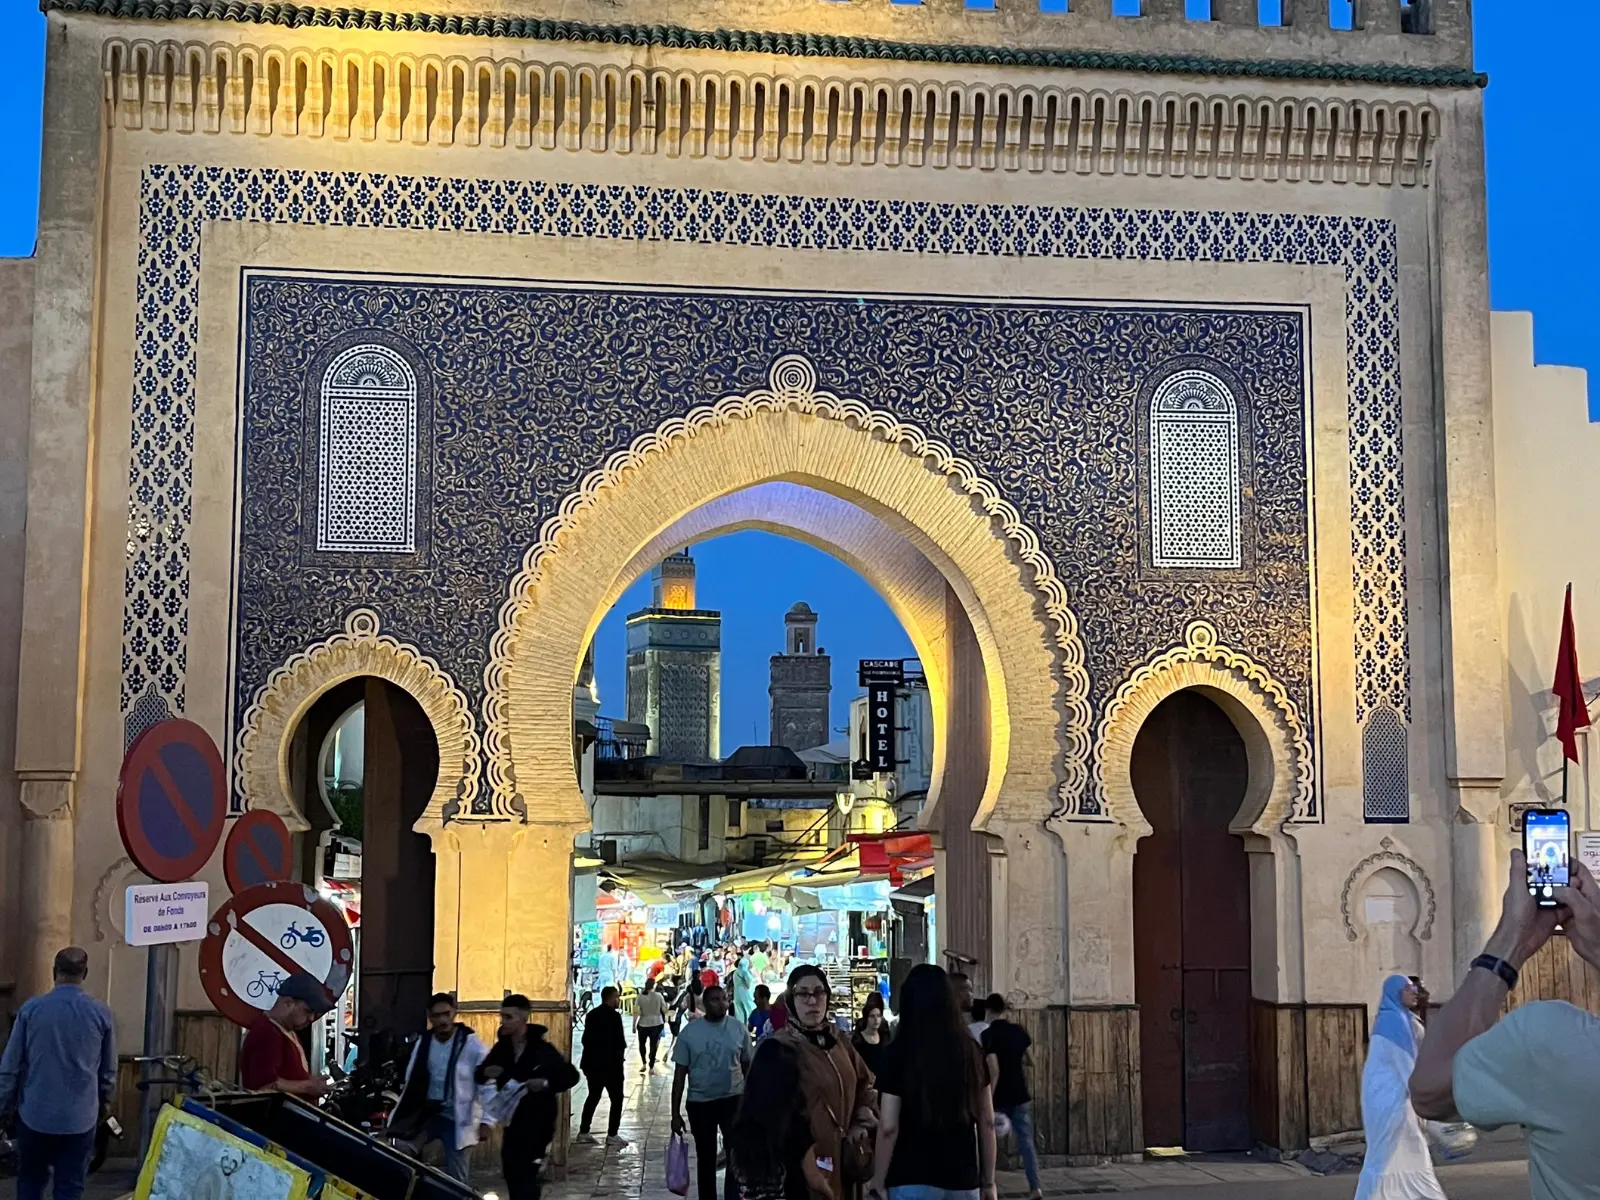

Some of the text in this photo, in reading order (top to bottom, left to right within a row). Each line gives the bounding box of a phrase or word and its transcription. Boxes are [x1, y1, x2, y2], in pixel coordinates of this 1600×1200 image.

[877, 691, 888, 767] HOTEL
[160, 893, 171, 901] Aux
[173, 892, 205, 901] Convoyeurs
[158, 906, 184, 916] de Fonds
[143, 925, 152, 933] DE
